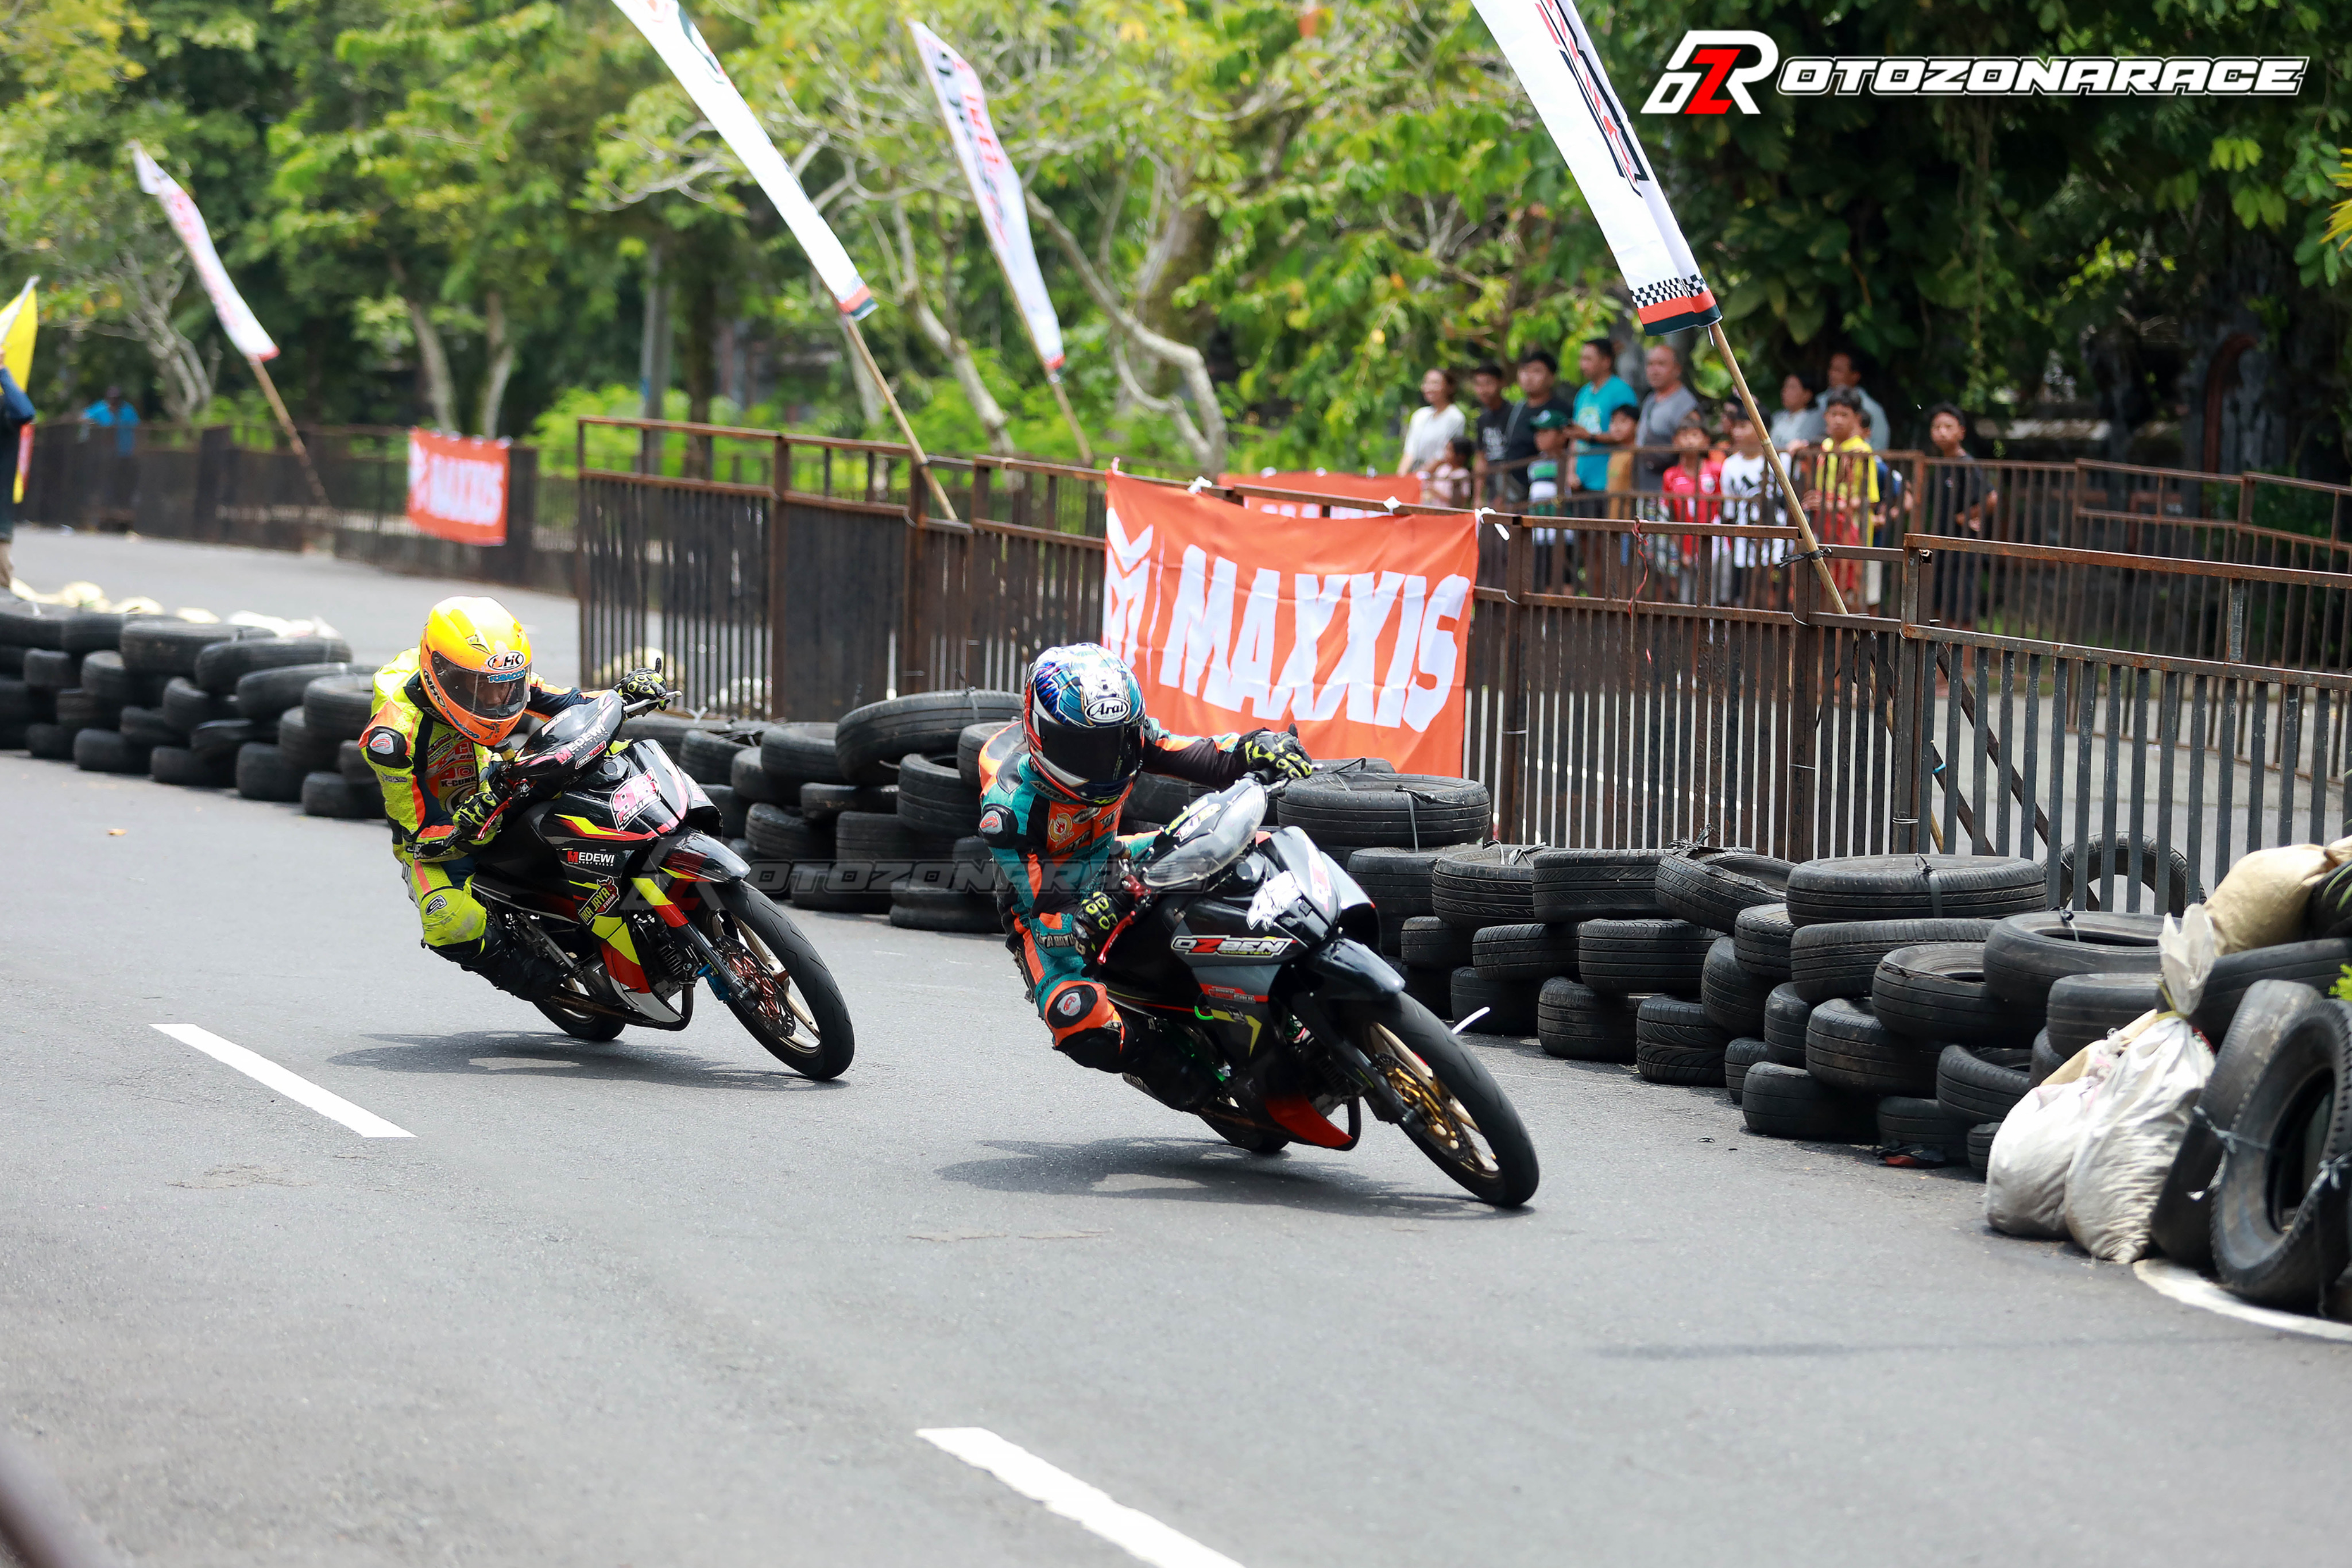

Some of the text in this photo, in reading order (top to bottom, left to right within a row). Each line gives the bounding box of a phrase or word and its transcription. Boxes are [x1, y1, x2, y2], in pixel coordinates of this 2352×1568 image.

[1159, 544, 1470, 733] MAXXIS
[1089, 701, 1124, 718] Arai
[554, 723, 607, 765] MEDEWI
[567, 850, 614, 864] MEDEWI
[591, 886, 610, 912] JAYA
[602, 893, 616, 909] FARM
[1174, 938, 1286, 953] OZBEN
